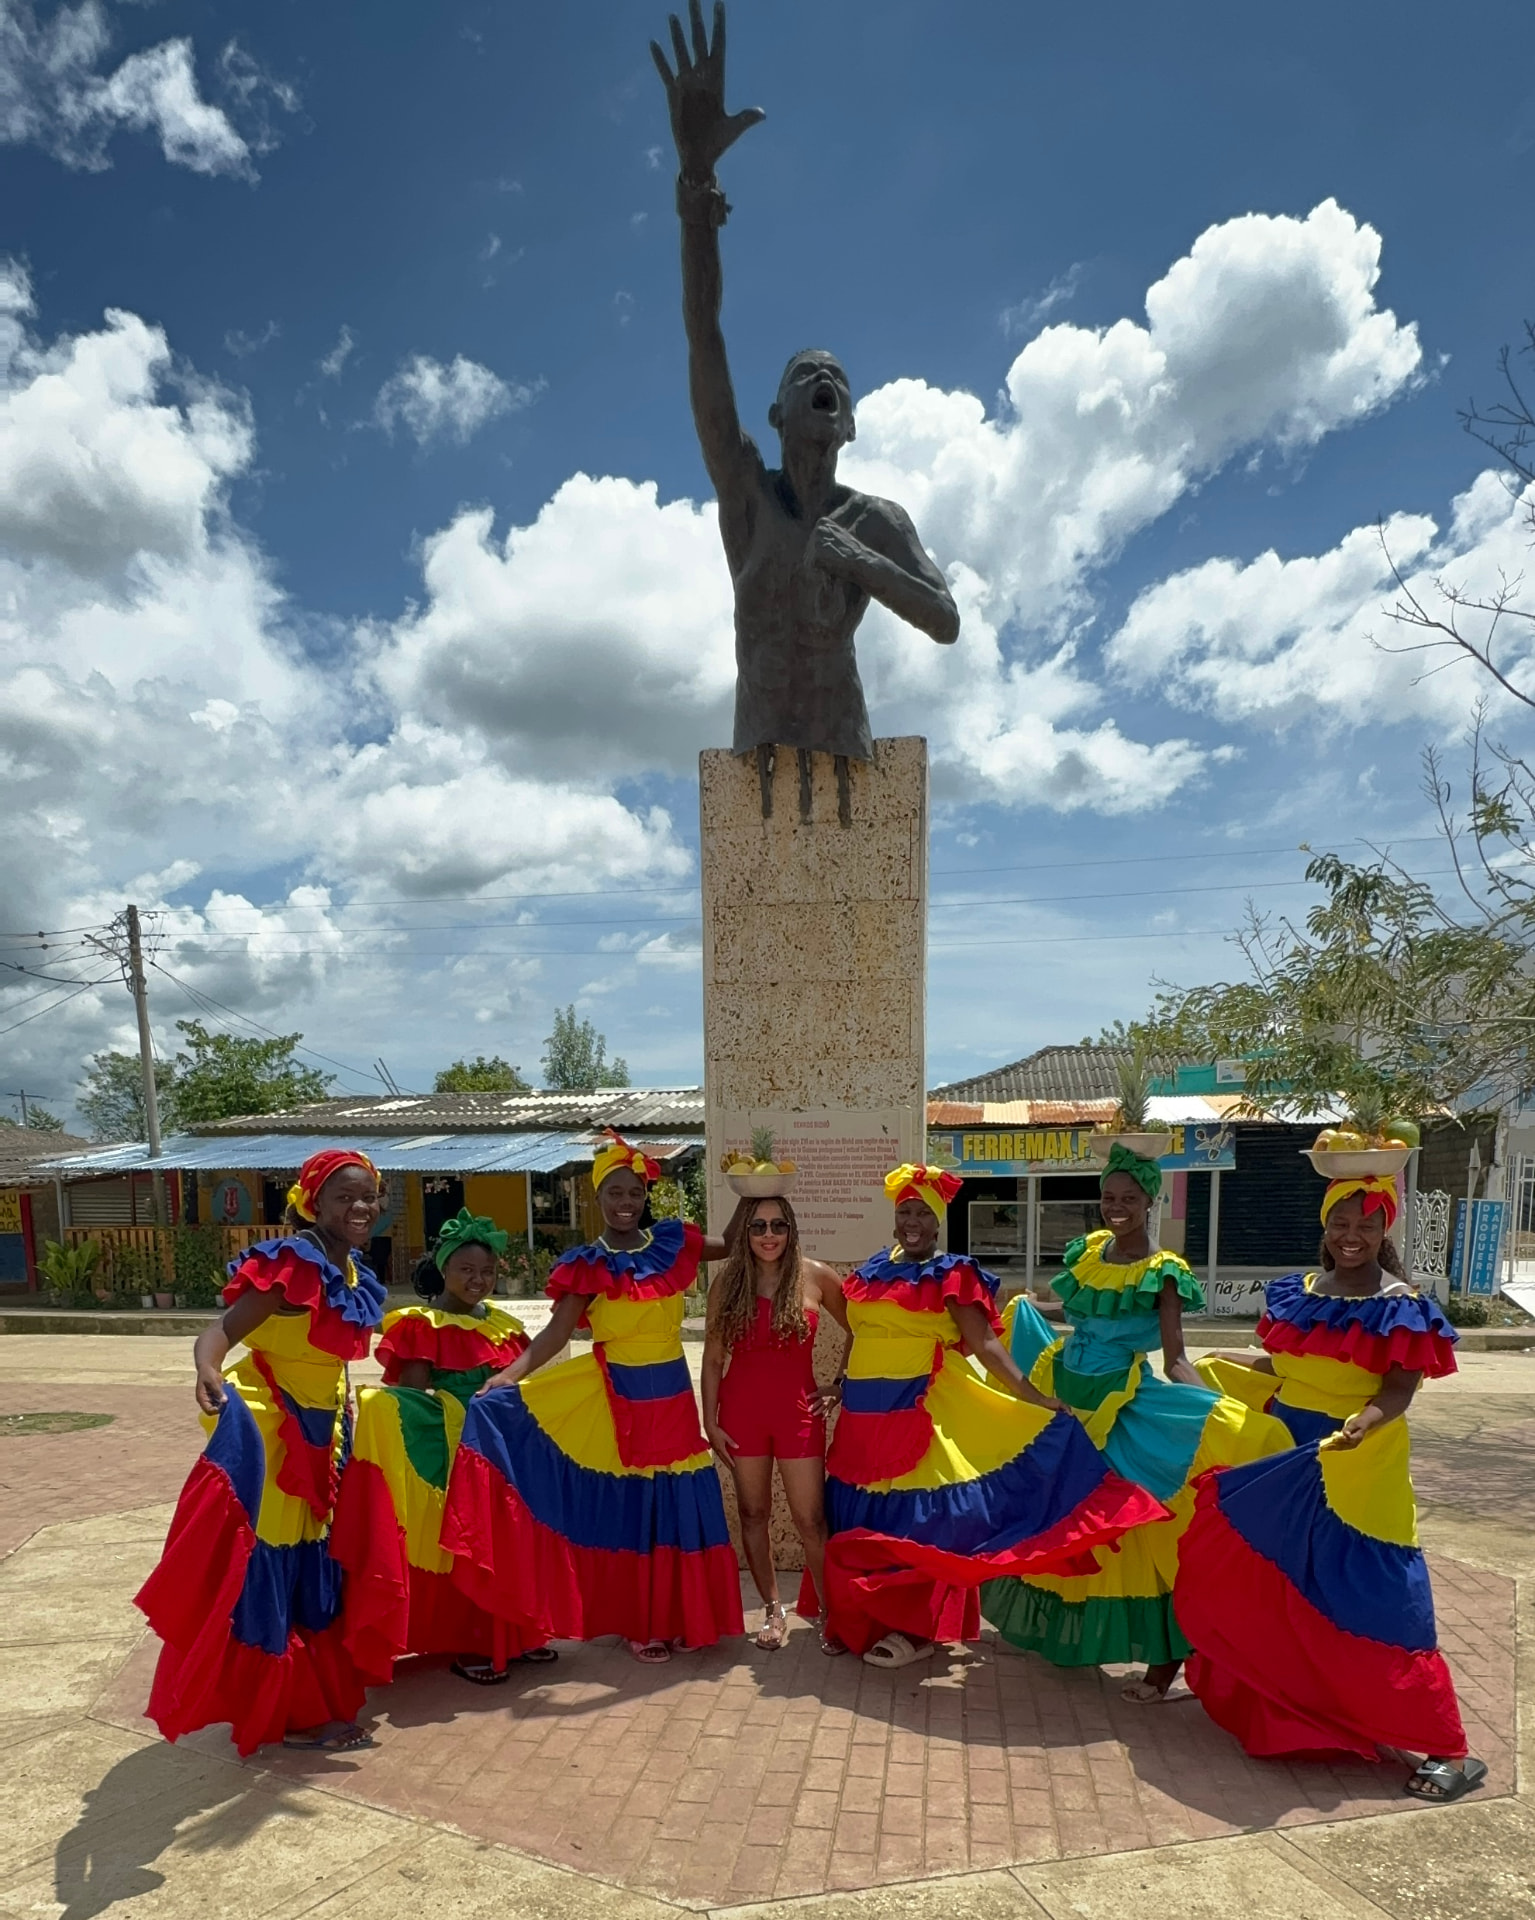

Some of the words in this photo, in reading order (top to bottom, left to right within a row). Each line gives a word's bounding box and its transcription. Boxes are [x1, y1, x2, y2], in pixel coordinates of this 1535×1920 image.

[860, 1178, 886, 1187] PALENQU
[962, 1131, 1074, 1161] FERREMAX
[1451, 1202, 1467, 1287] DROGUERIA
[1472, 1204, 1491, 1290] DROGUERIA
[1482, 1204, 1501, 1291] PAPELERIA
